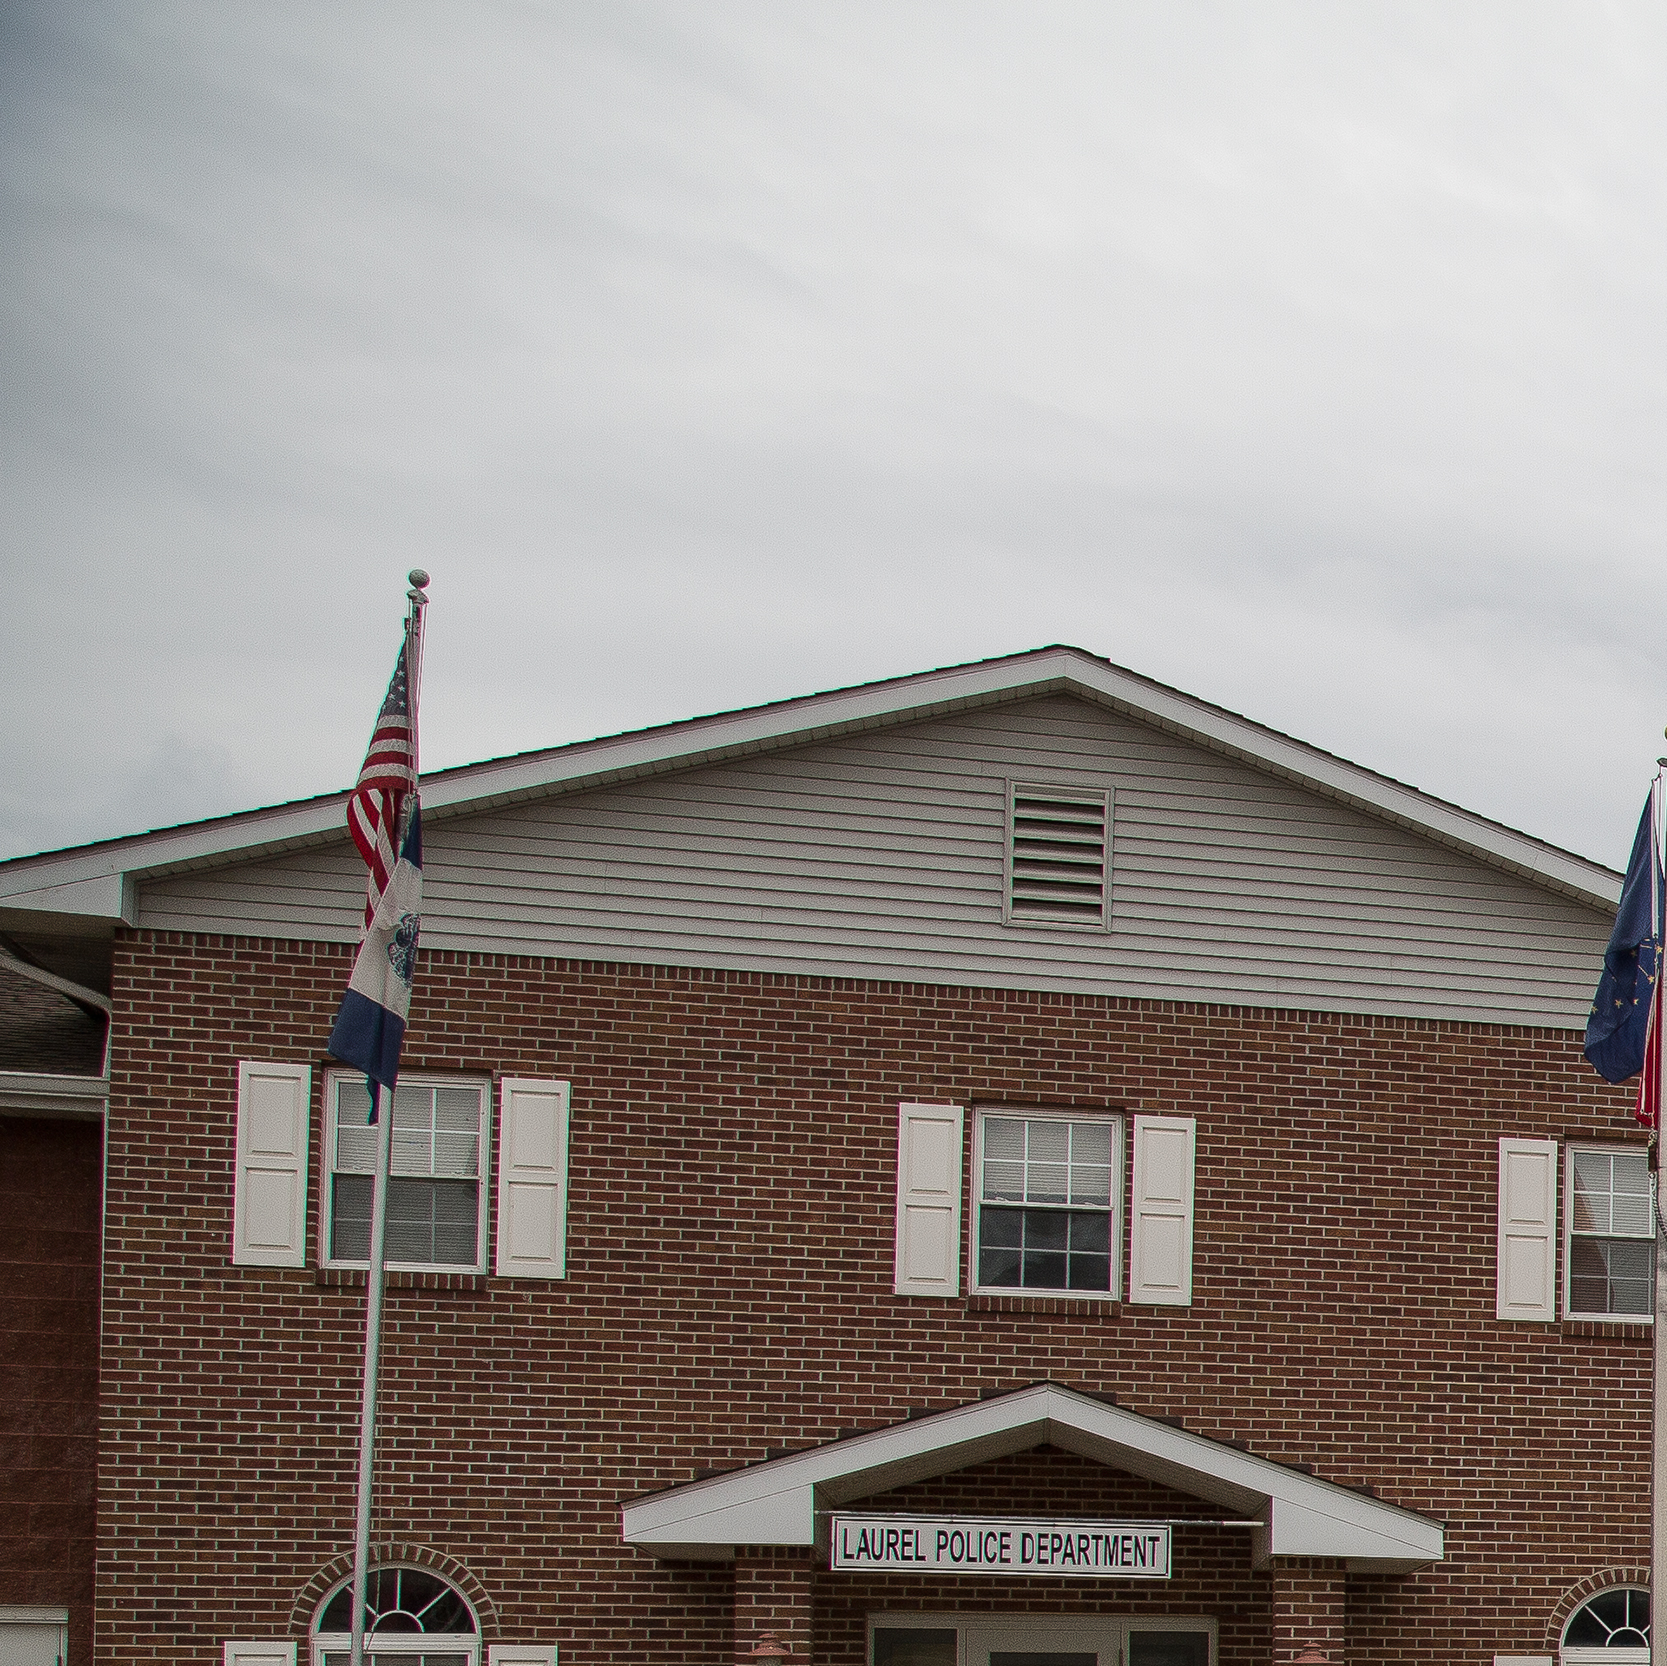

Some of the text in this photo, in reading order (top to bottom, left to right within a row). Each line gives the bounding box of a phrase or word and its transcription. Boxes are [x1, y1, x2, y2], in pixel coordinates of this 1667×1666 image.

[843, 1528, 1160, 1567] LAUREL POLICE DEPARTMENT
